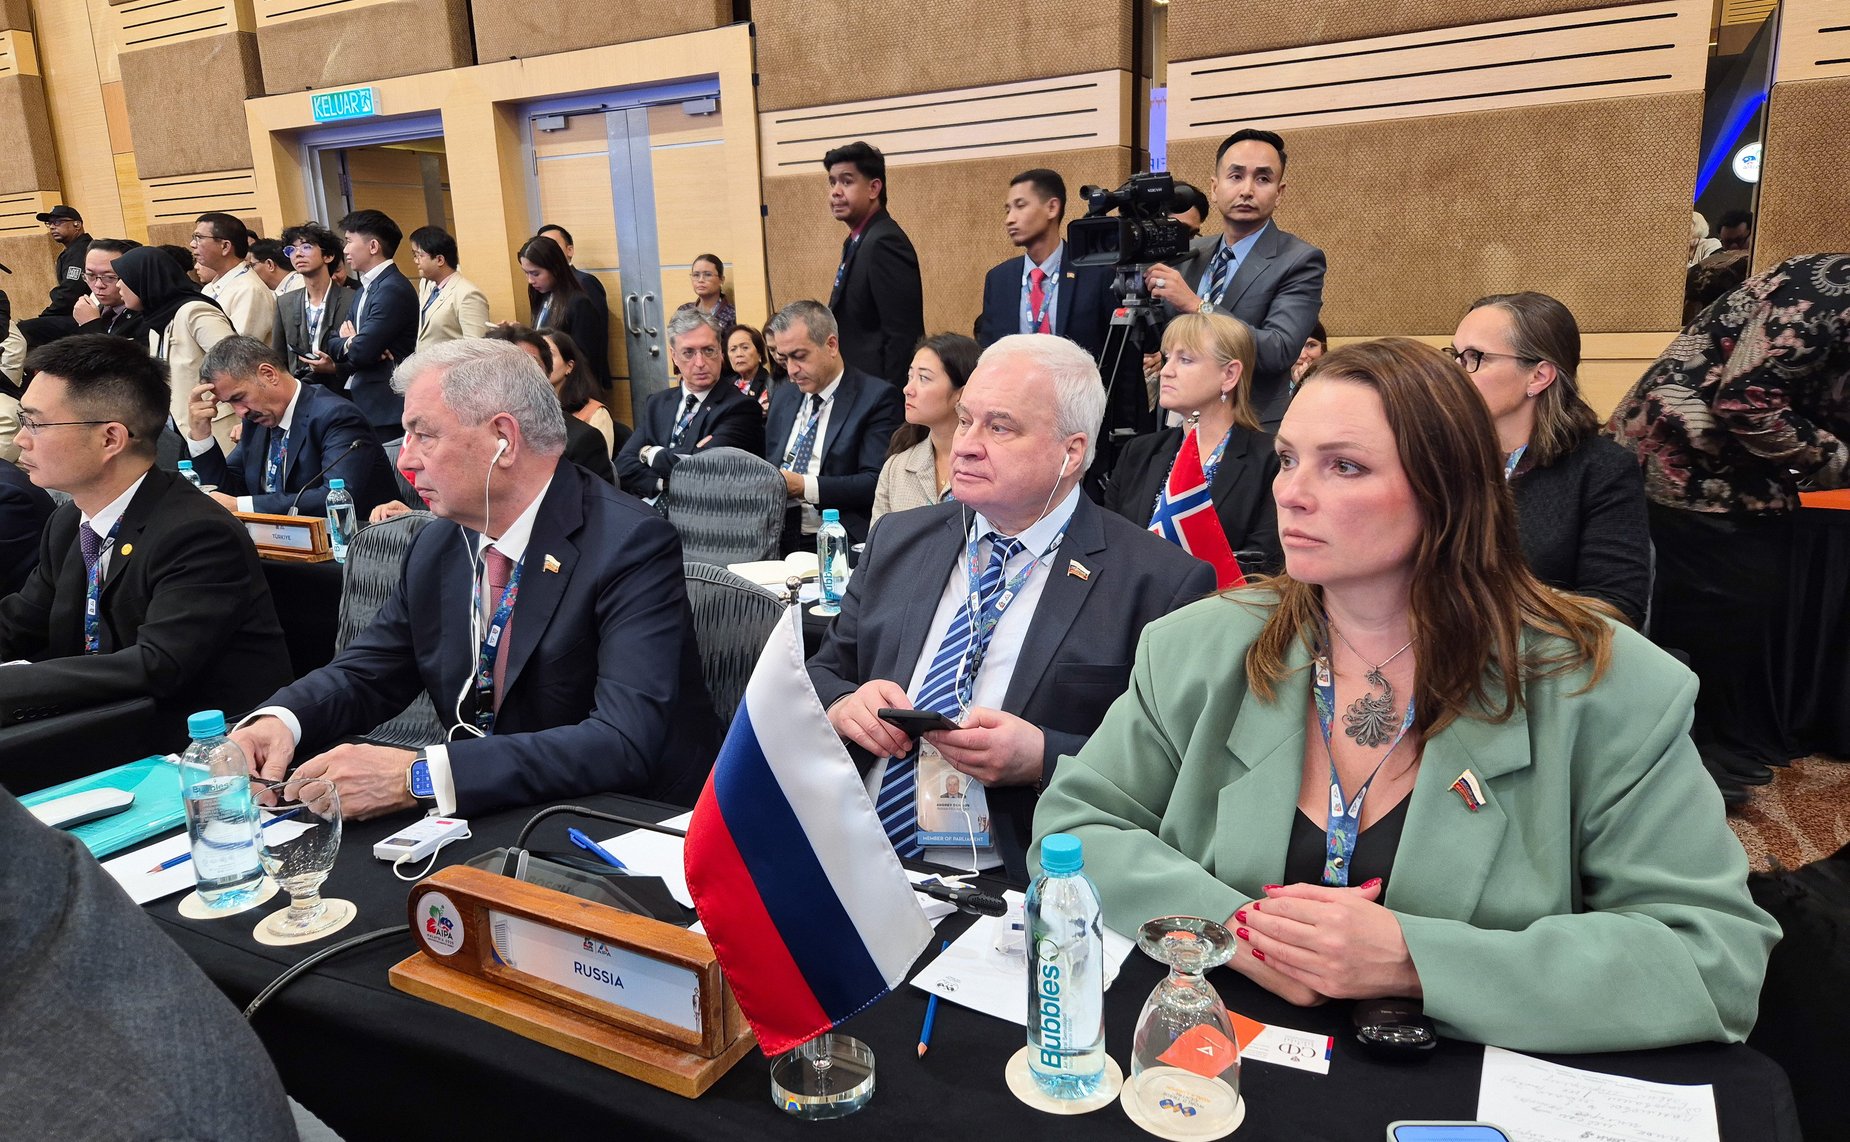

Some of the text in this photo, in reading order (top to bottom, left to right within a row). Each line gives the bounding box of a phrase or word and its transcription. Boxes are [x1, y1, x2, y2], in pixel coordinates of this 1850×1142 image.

[313, 92, 359, 118] KELUAR
[436, 929, 453, 940] AIPA
[574, 961, 624, 989] RUSSIA
[1040, 964, 1062, 1069] Bubbles
